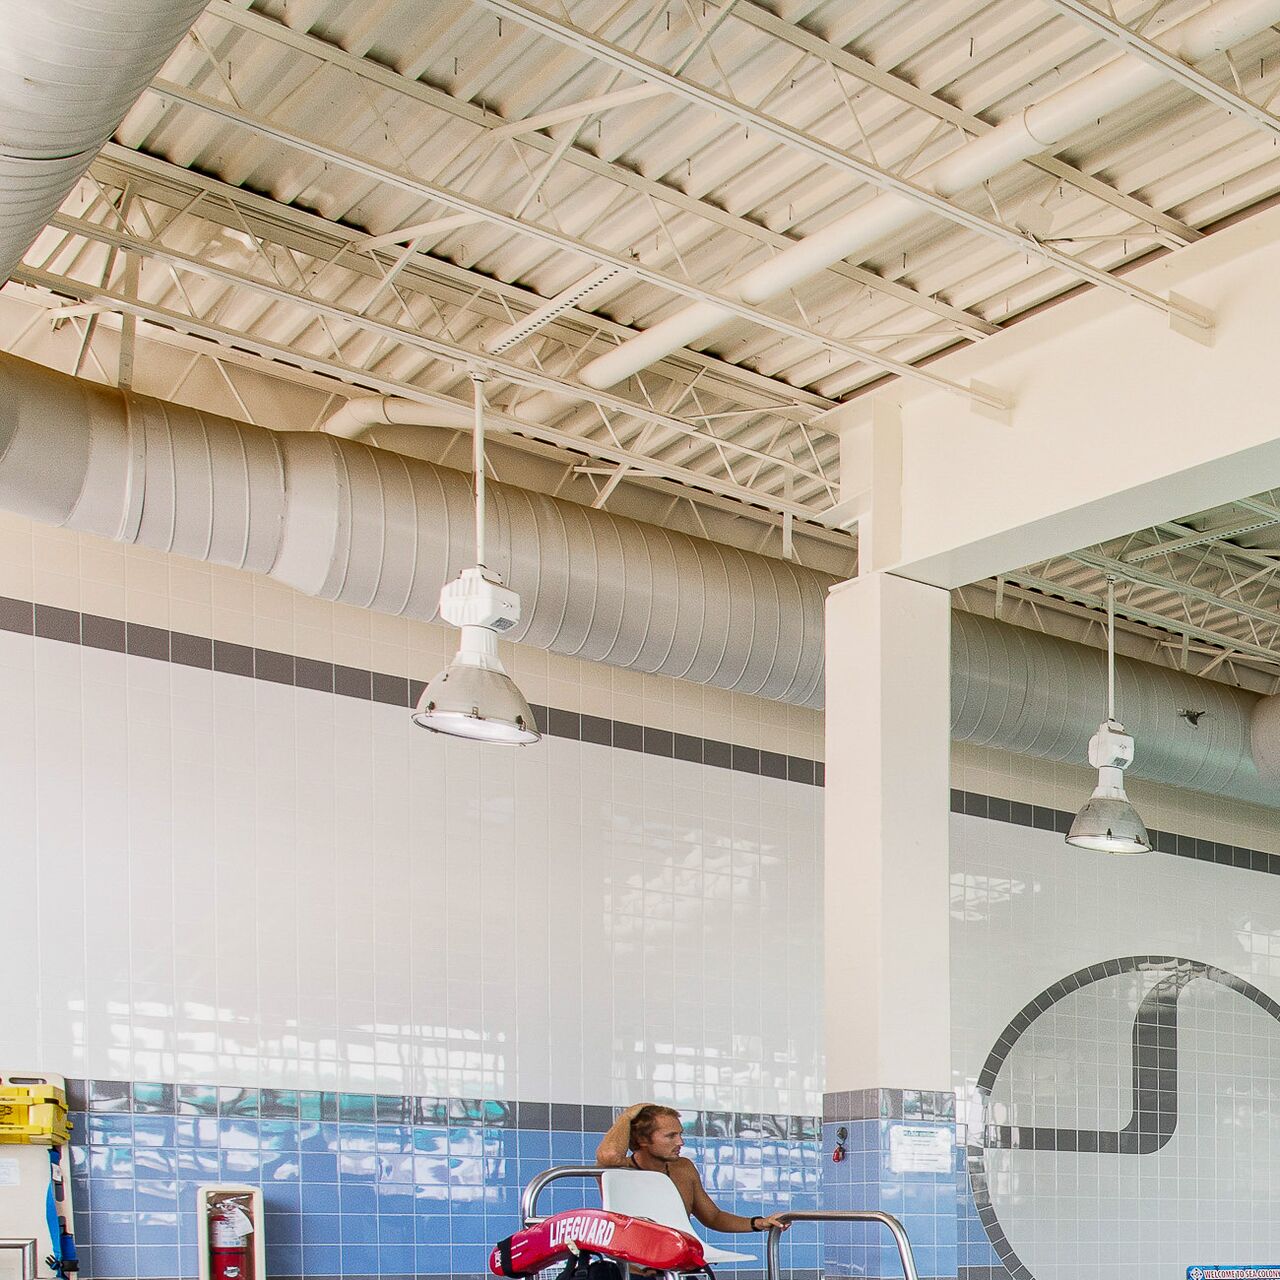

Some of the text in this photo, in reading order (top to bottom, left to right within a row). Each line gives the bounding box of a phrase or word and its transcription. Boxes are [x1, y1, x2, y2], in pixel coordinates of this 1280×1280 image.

[550, 1216, 616, 1248] LIFEGUARD
[1204, 1269, 1280, 1279] WELCOME TO SEA COLONY
